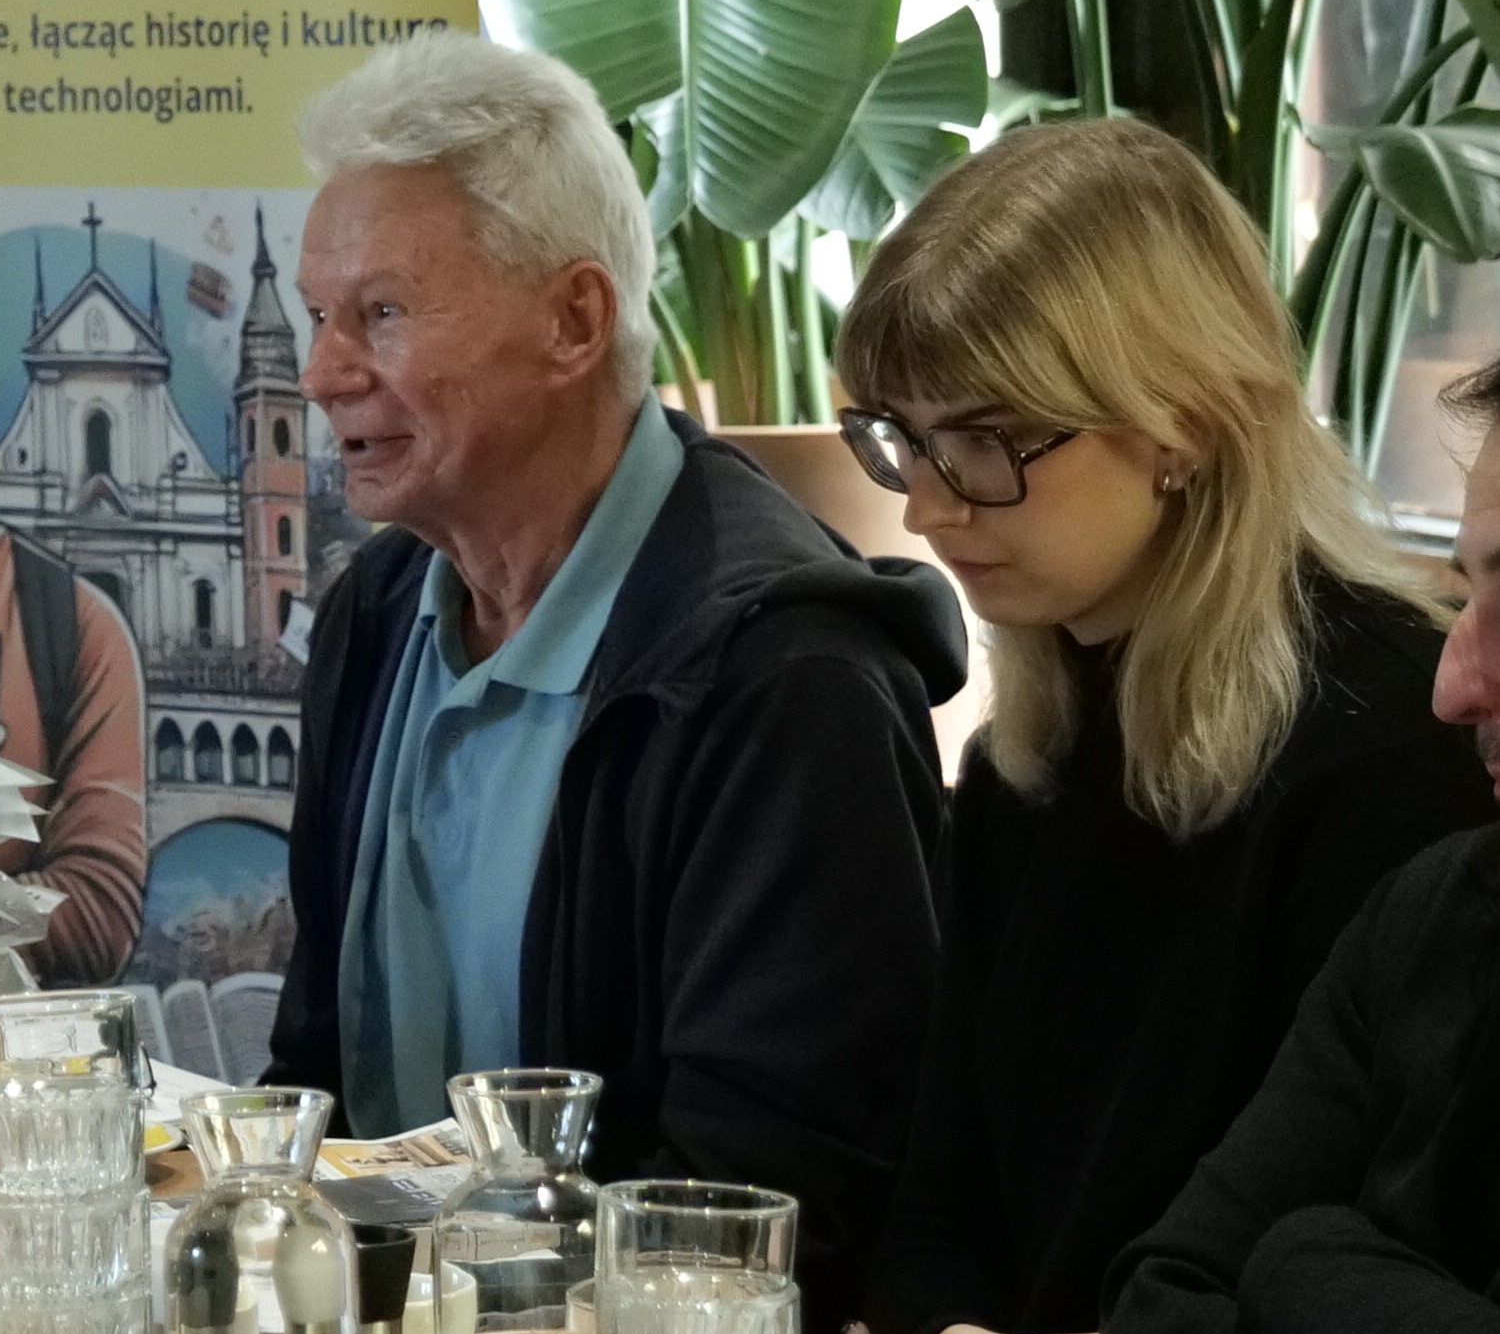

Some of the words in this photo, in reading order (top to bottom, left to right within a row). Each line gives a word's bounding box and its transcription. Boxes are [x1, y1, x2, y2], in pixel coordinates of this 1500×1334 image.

[31, 13, 136, 58] łącząc
[146, 11, 270, 57] historię
[281, 11, 289, 46] i
[5, 76, 253, 123] technologiami.
